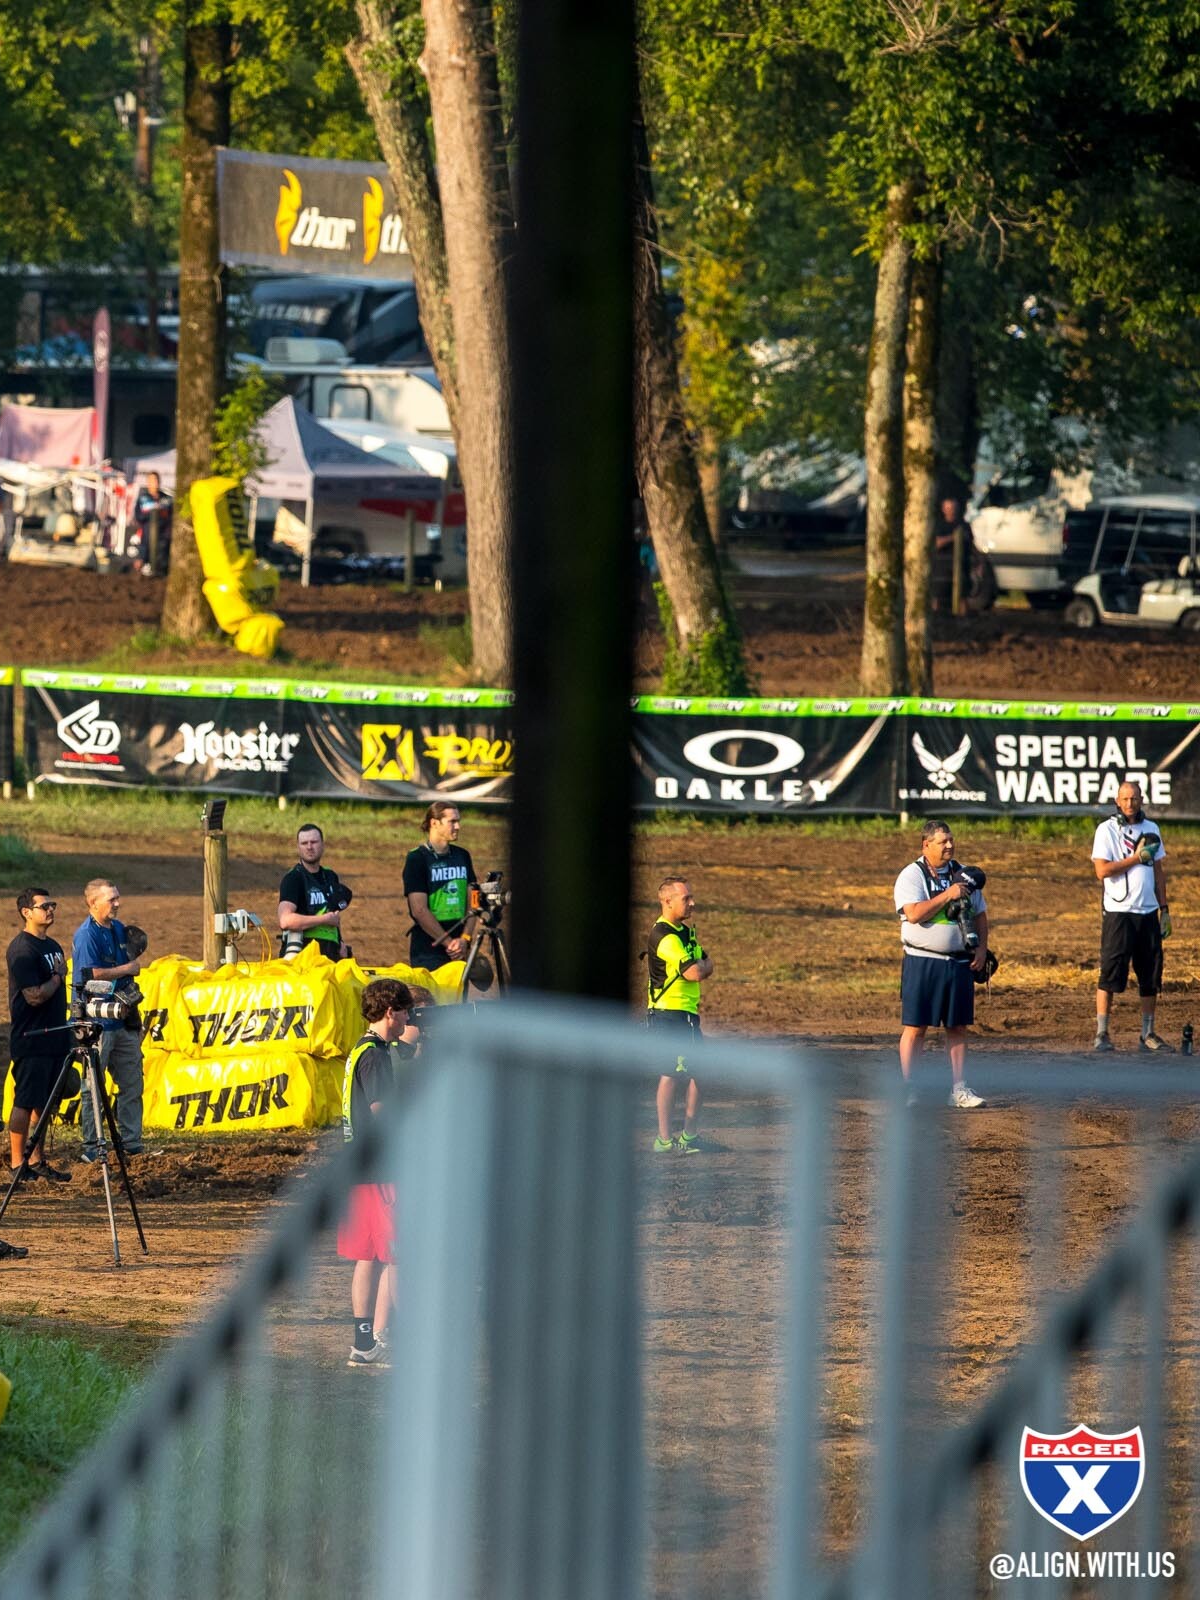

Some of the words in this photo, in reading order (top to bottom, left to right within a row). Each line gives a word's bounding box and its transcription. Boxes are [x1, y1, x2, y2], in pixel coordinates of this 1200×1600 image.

[290, 206, 356, 250] thor
[380, 213, 411, 254] th
[174, 719, 300, 765] Hoosier
[423, 732, 513, 777] PRO
[995, 734, 1148, 768] SPECIAL
[654, 776, 834, 801] OAKLEY
[920, 788, 942, 800] AIR
[943, 789, 987, 802] FORCE
[431, 866, 468, 882] MEDIA
[188, 1004, 314, 1048] THOR
[170, 1072, 289, 1130] THOR
